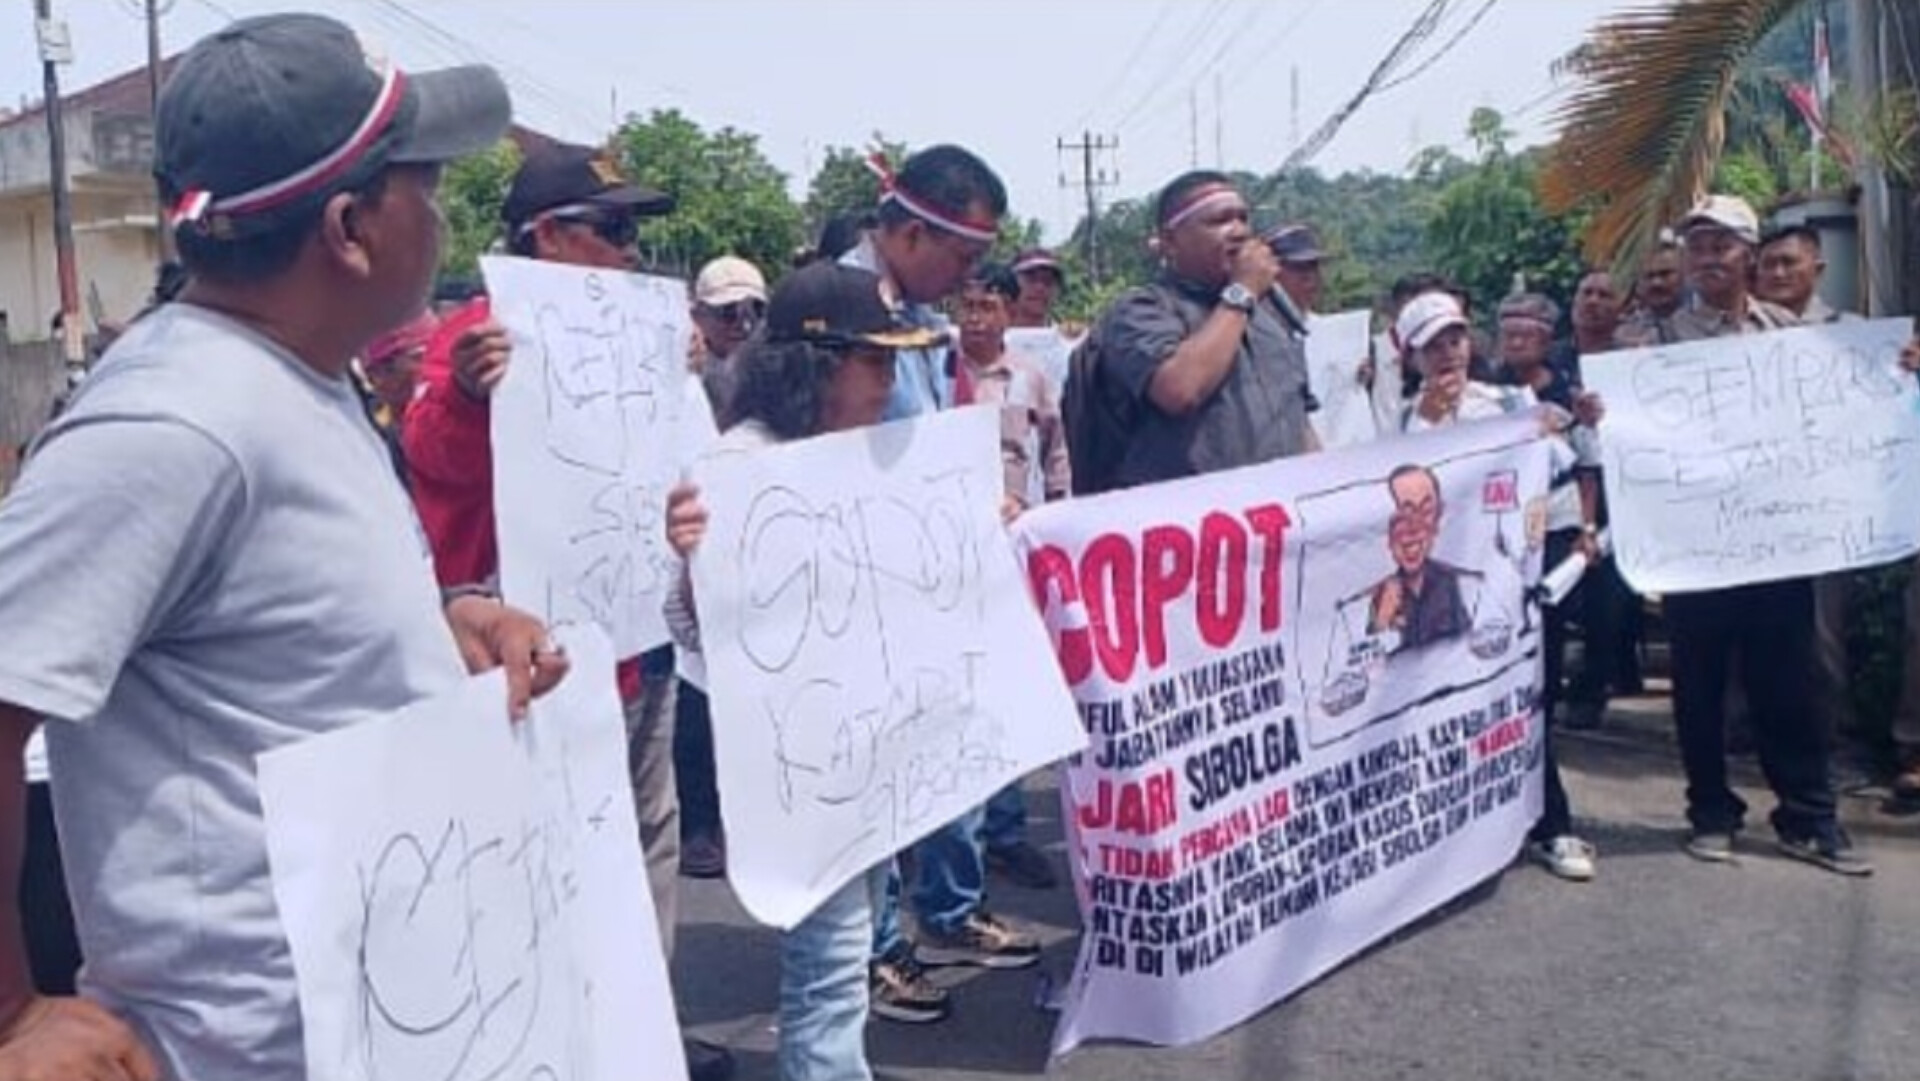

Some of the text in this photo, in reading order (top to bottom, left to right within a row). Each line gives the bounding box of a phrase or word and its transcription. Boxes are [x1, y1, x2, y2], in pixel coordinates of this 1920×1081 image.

[1028, 503, 1291, 687] COPOT
[1076, 699, 1128, 735] FUL
[1184, 715, 1302, 812] SIBOLGA
[1099, 844, 1174, 881] TIDAK
[1253, 787, 1291, 830] LAGI
[1294, 759, 1353, 809] DENGAN
[1256, 807, 1321, 862] SELAMA
[1349, 763, 1421, 816] MENURUT
[1360, 797, 1414, 844] KASUS
[1135, 946, 1164, 978] DI
[1259, 875, 1320, 933] HUKUM
[1380, 817, 1442, 868] SIBOLGA
